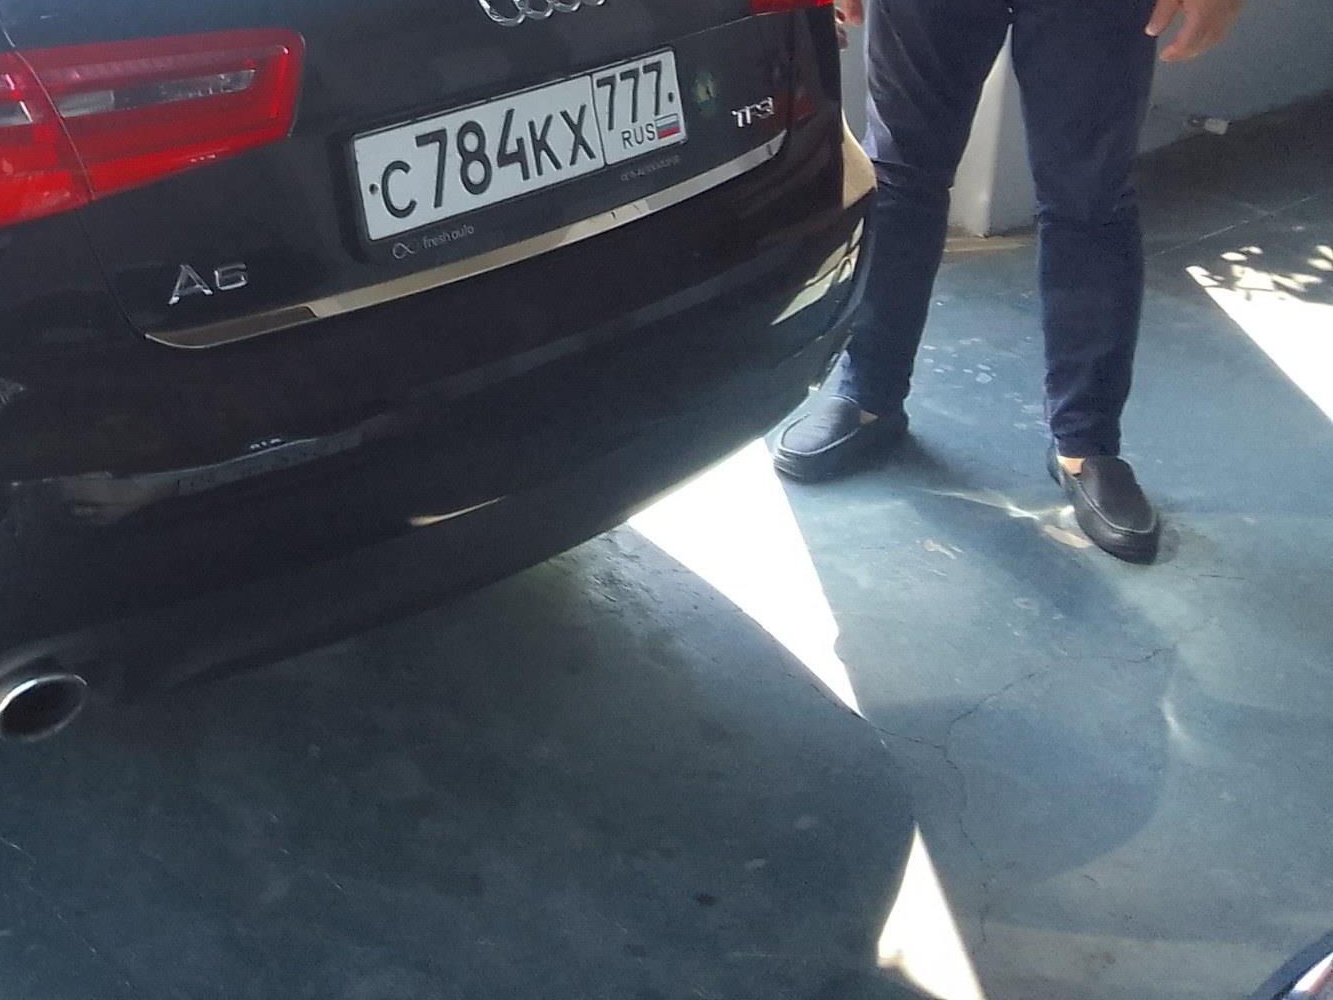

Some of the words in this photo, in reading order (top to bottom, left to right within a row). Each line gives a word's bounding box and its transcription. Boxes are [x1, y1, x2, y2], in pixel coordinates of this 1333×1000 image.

[596, 61, 663, 131] 777
[621, 122, 656, 150] RUS
[168, 262, 248, 305] A6
